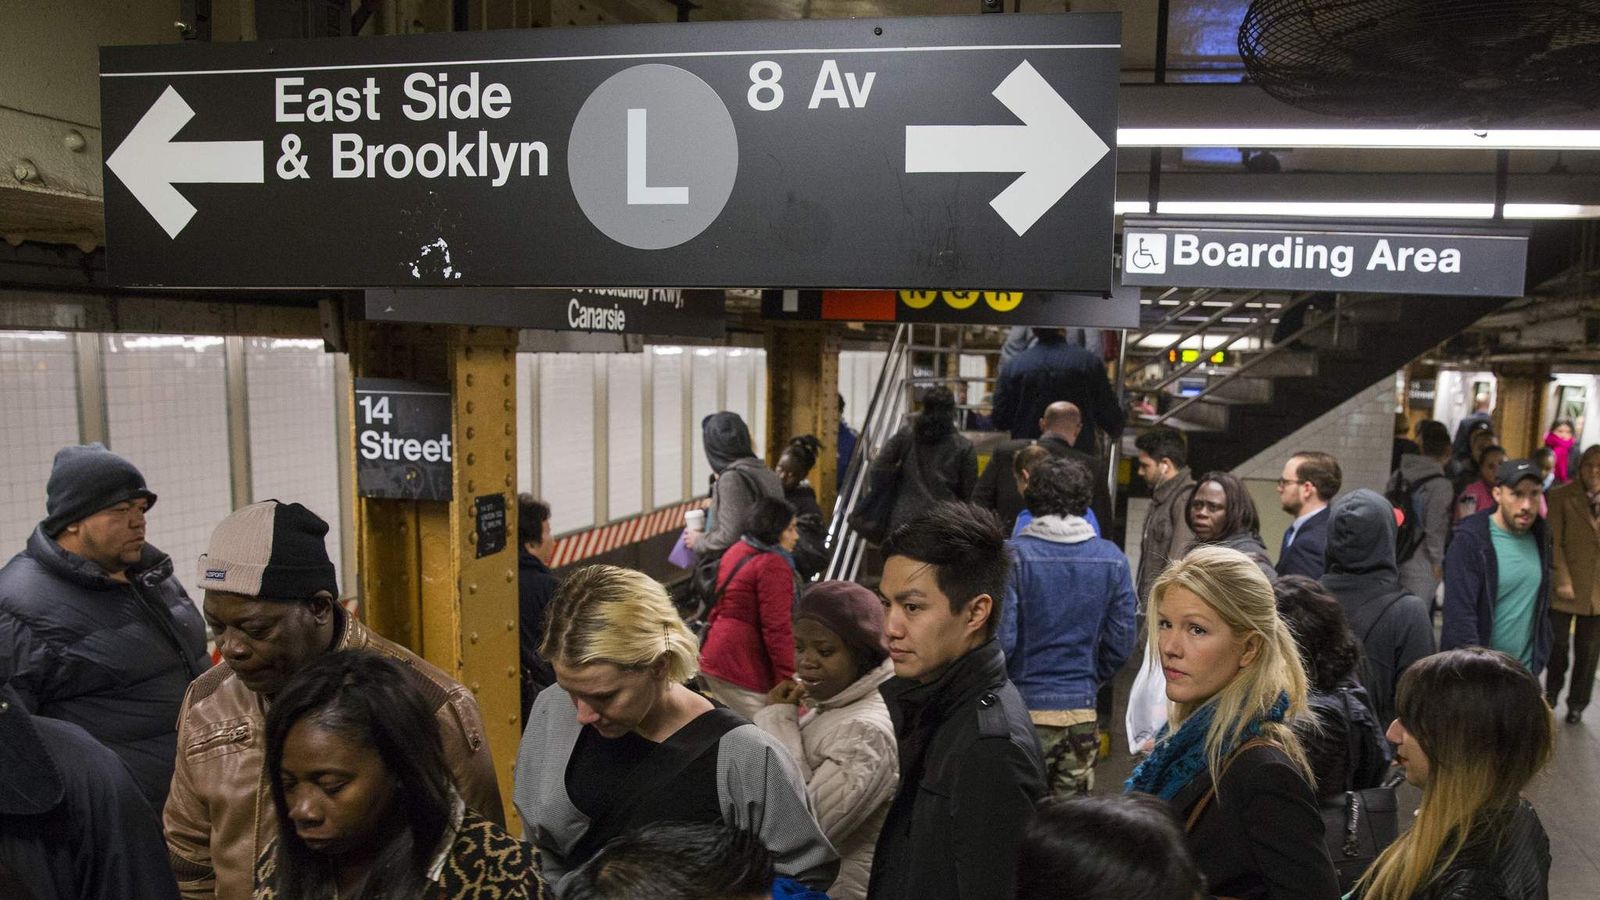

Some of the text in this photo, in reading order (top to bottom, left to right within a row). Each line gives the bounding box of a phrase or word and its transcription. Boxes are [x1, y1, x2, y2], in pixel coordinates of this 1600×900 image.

[276, 72, 511, 122] East Side
[747, 59, 876, 111] 8 Av
[277, 131, 548, 186] & Brooklyn
[628, 109, 688, 204] L
[1173, 234, 1461, 278] Boarding Area
[568, 298, 626, 331] Canarsie
[359, 396, 392, 424] 14
[361, 430, 451, 462] Street
